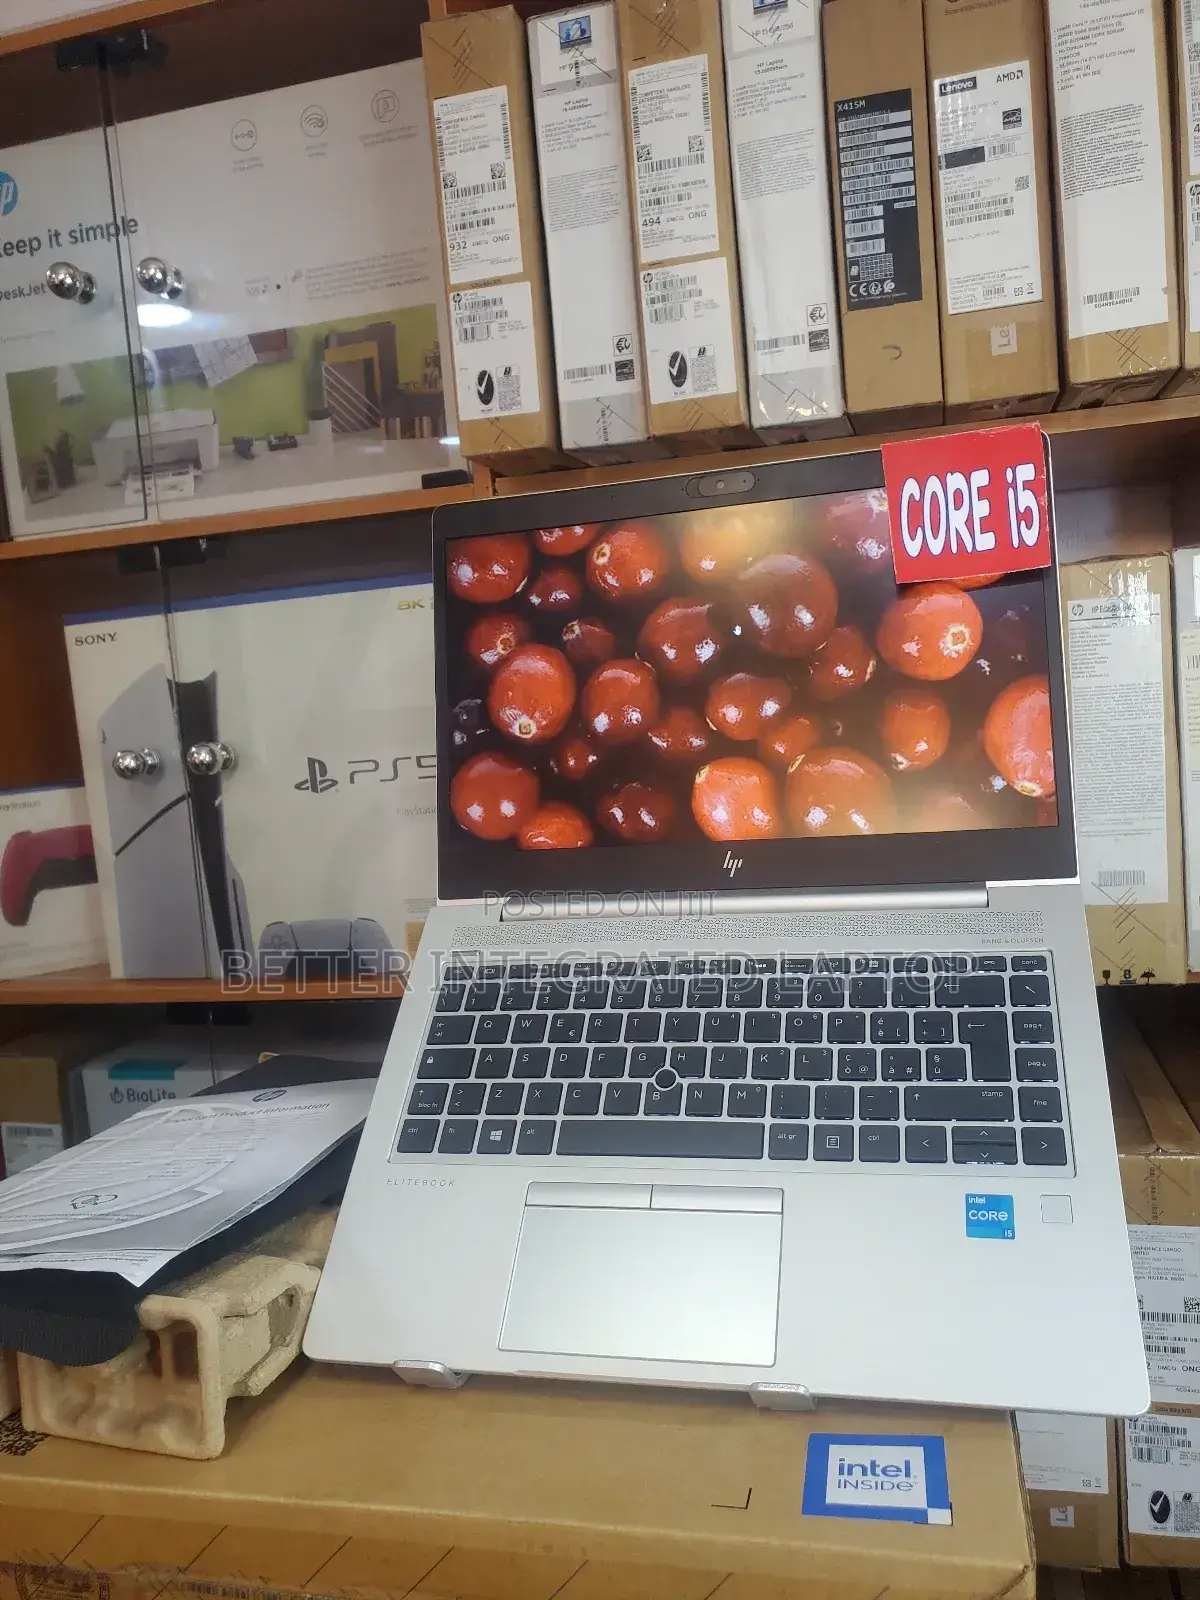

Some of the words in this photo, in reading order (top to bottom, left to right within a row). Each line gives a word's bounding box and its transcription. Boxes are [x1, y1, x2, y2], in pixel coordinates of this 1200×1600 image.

[996, 71, 1016, 84] AMD
[941, 80, 974, 93] Lenovo
[837, 99, 866, 113] X415M
[641, 216, 661, 228] 494
[688, 209, 707, 219] ONG
[0, 235, 42, 258] eep
[47, 228, 63, 249] it
[68, 215, 140, 246] simple
[449, 240, 467, 251] 932
[492, 233, 510, 243] ONG
[900, 467, 997, 559] CORE
[1004, 462, 1041, 550] i5
[74, 631, 118, 647] SONY
[348, 754, 436, 785] PS5
[471, 998, 476, 1006] 1
[506, 997, 514, 1005] 2
[543, 996, 550, 1004] 3
[617, 995, 624, 1003] 5
[655, 994, 662, 1002] 6
[694, 994, 700, 1002] 7
[734, 994, 740, 1002] 8
[484, 1020, 493, 1029] Q
[521, 1019, 532, 1028] W
[556, 1019, 564, 1028] E
[594, 1018, 602, 1027] R
[632, 1018, 640, 1026] T
[672, 1018, 680, 1026] Y
[712, 1018, 720, 1026] U
[752, 1018, 755, 1026] I
[794, 1018, 803, 1027] O
[835, 1018, 843, 1027] P
[878, 1017, 884, 1025] é
[878, 1029, 884, 1037] è
[484, 1054, 493, 1062] A
[522, 1054, 530, 1062] S
[559, 1054, 568, 1062] D
[598, 1053, 605, 1061] F
[638, 1052, 647, 1061] G
[677, 1052, 686, 1061] H
[718, 1054, 725, 1062] J
[760, 1054, 768, 1062] K
[802, 1054, 810, 1063] L
[858, 1064, 869, 1074] @
[888, 1066, 895, 1074] à
[125, 1088, 176, 1103] BioLite
[494, 1089, 503, 1098] Z
[533, 1089, 542, 1098] X
[572, 1089, 581, 1098] C
[613, 1089, 622, 1098] V
[652, 1091, 661, 1100] B
[694, 1090, 703, 1099] N
[736, 1090, 747, 1100] M
[980, 1090, 1004, 1098] stamp
[407, 1126, 419, 1134] ctrl
[386, 1178, 456, 1187] ELITEBOOK
[968, 1196, 986, 1204] intel
[1004, 1229, 1013, 1237] i5
[1181, 1364, 1200, 1373] ONG
